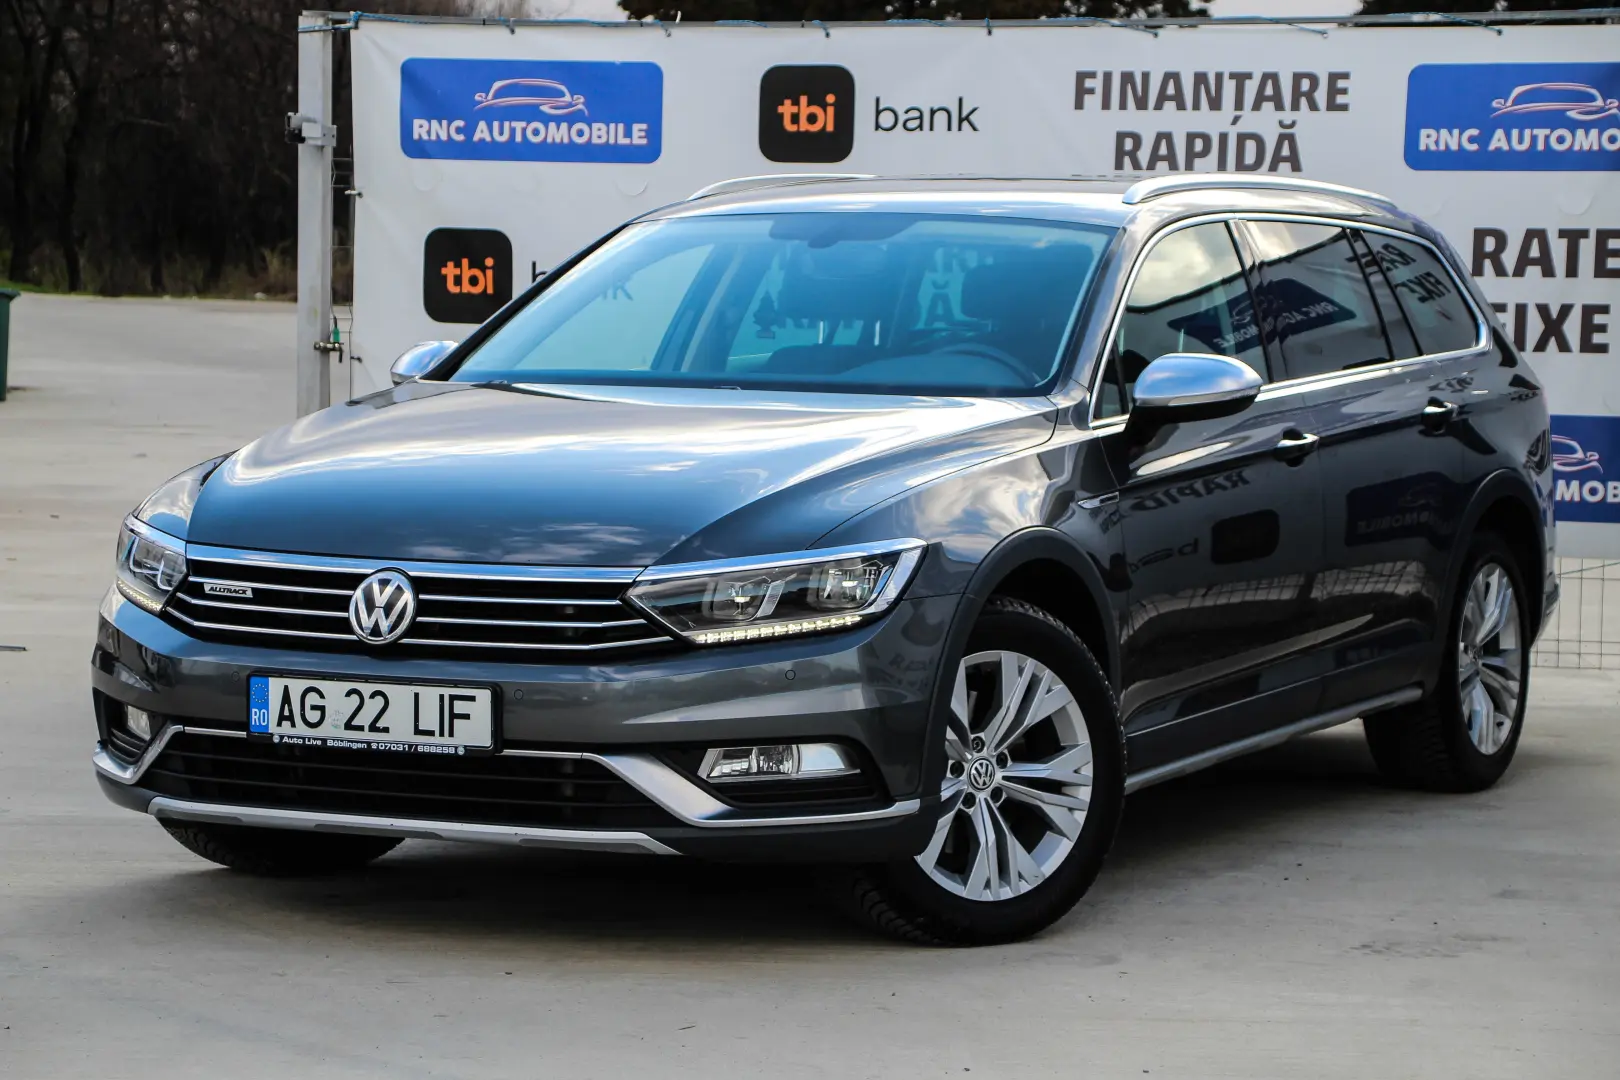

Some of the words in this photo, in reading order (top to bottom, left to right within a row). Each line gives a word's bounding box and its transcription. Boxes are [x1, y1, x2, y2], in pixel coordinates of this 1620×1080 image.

[776, 93, 836, 133] tbi
[873, 96, 980, 132] bank
[412, 118, 466, 142] RNC
[473, 120, 648, 146] AUTOMOBILE
[1419, 128, 1480, 151] RNC
[1471, 227, 1620, 279] RATE
[441, 257, 495, 295] tbi
[208, 585, 249, 596] ALLTRACK
[251, 708, 268, 726] RO
[276, 684, 327, 729] AG
[343, 687, 390, 734] 22
[413, 691, 477, 738] LIF
[282, 736, 303, 744] Auto
[305, 737, 322, 746] Live
[326, 739, 367, 749] Böblingen
